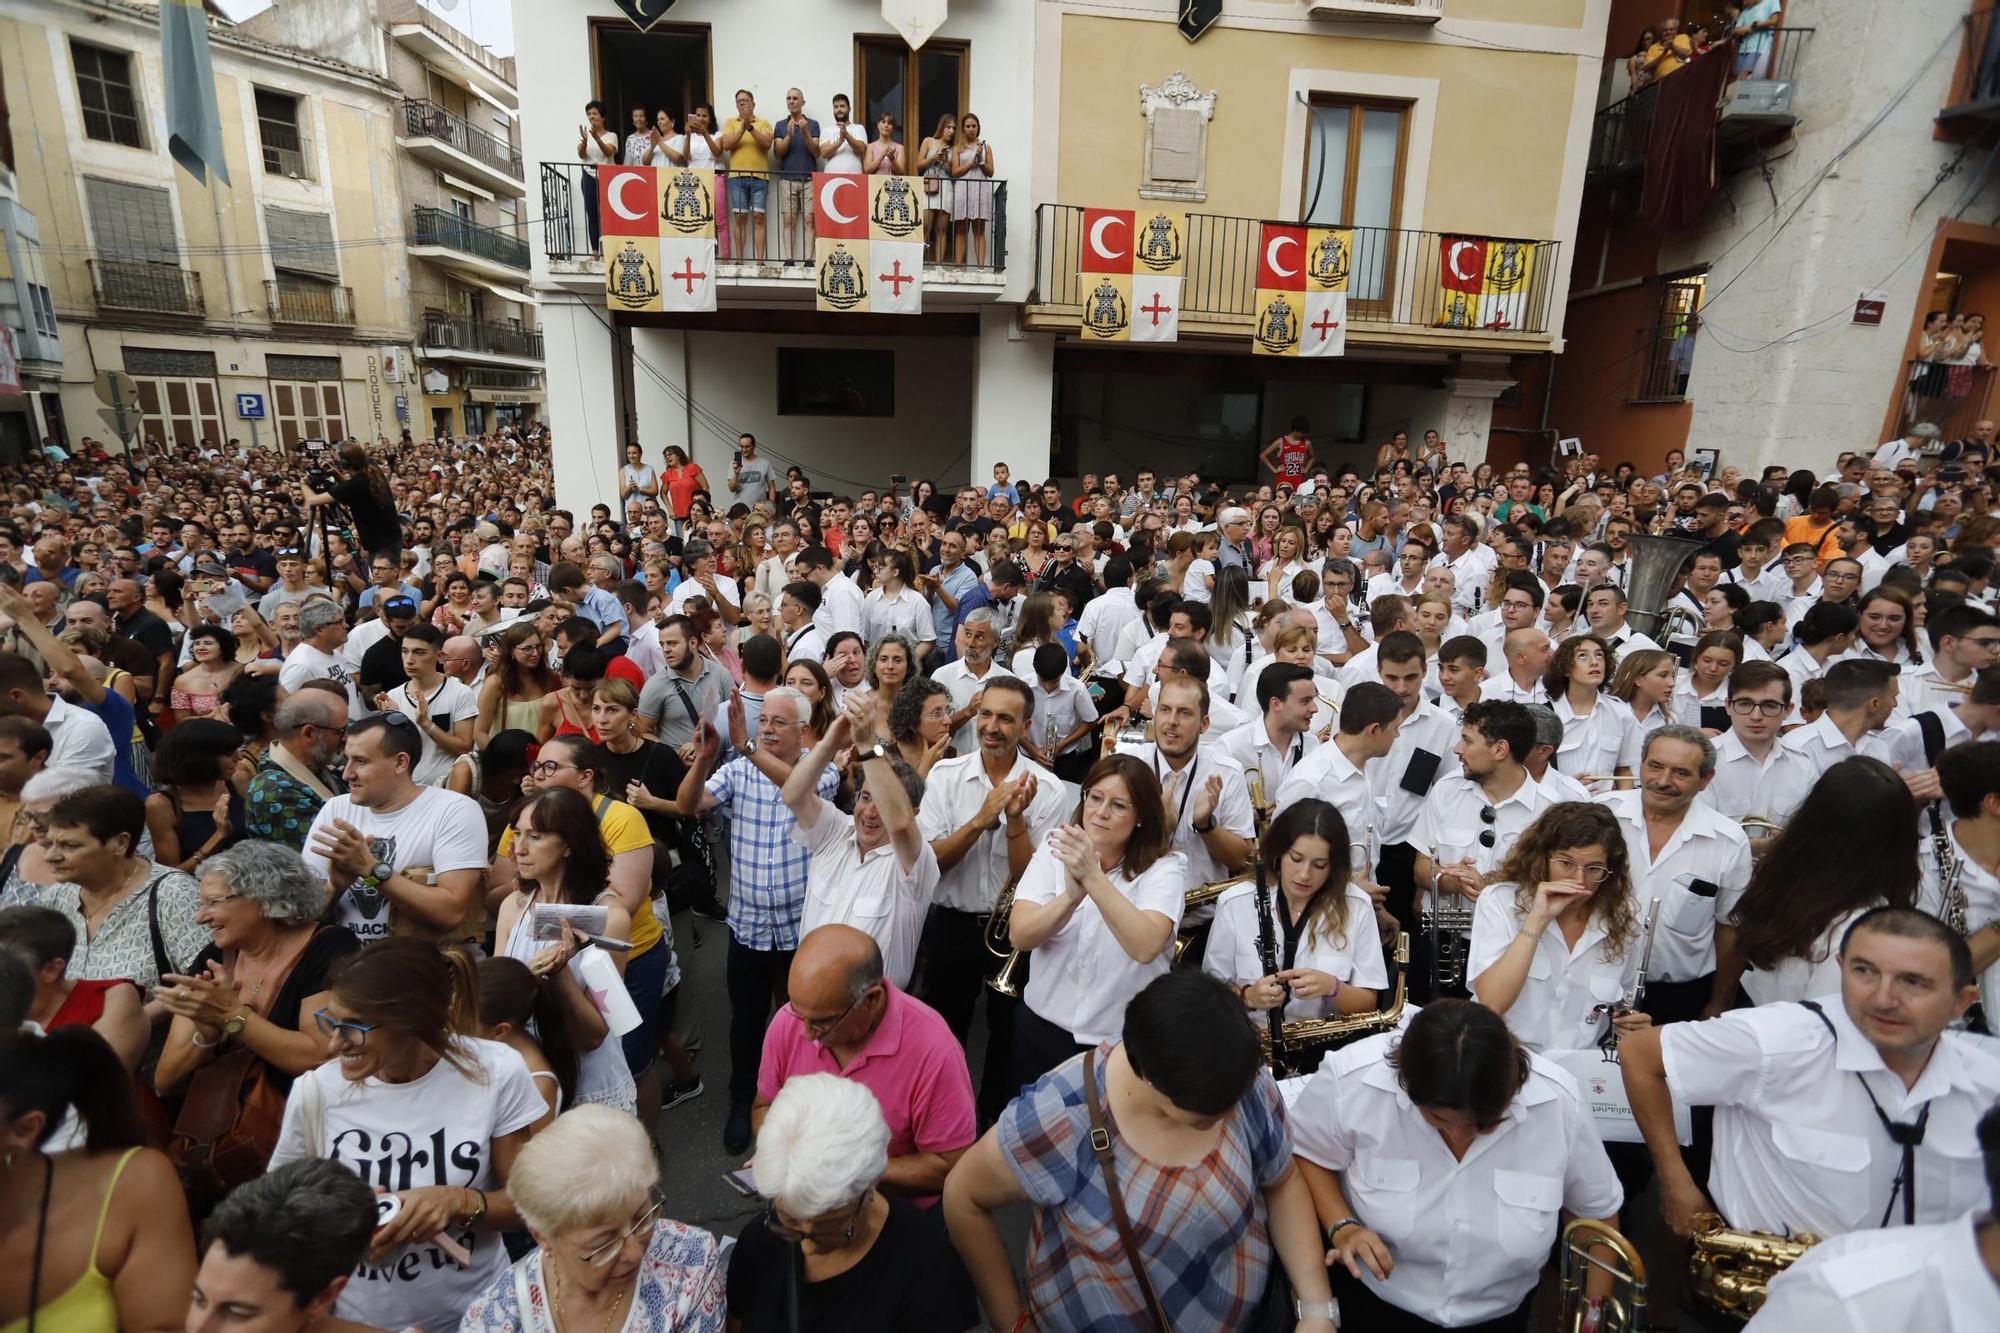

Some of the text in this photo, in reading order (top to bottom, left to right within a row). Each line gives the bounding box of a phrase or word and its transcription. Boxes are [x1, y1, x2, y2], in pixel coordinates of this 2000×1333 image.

[241, 396, 258, 415] P
[367, 355, 384, 441] DROGUERIA
[1286, 463, 1301, 477] 23
[331, 1127, 481, 1193] Girls
